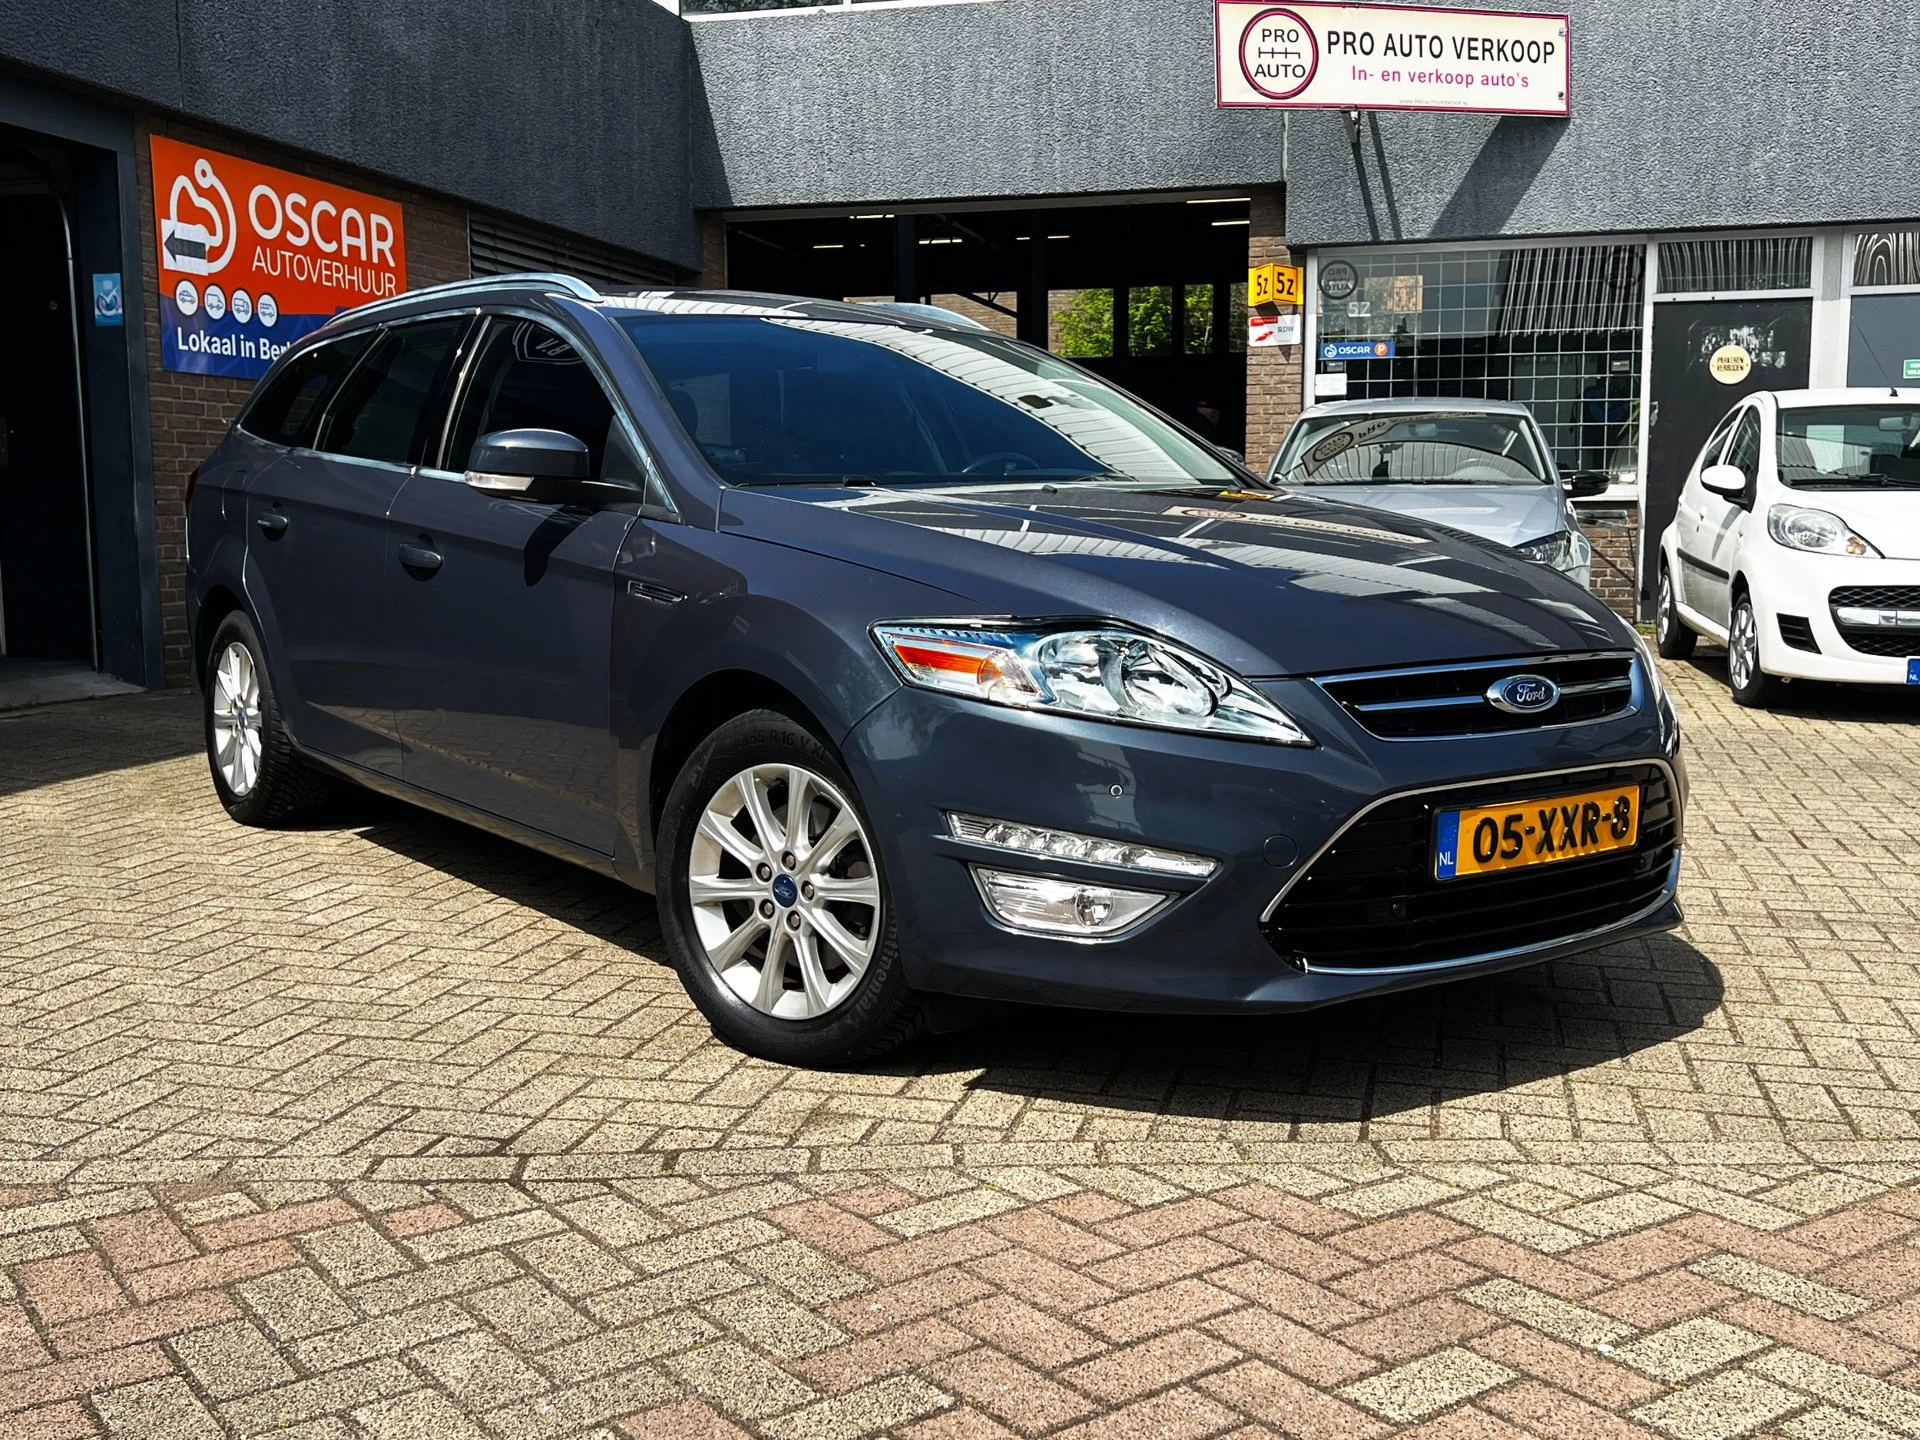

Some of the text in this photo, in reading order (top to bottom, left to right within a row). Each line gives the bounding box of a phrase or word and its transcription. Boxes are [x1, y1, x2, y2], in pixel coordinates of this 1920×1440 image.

[1262, 28, 1299, 43] PRO
[1328, 30, 1555, 64] PRO AUTO VERKOOP
[1254, 64, 1306, 79] AUTO
[1352, 65, 1529, 89] In- en verkoop auto's
[248, 184, 396, 267] OSCAR
[252, 246, 397, 297] AUTOVERHUUR
[177, 326, 292, 361] Lokaal in Ber
[1338, 344, 1385, 355] OSCAR P
[1516, 683, 1546, 702] Ford
[1472, 796, 1631, 864] 05-XXR-8
[1439, 851, 1454, 866] NL
